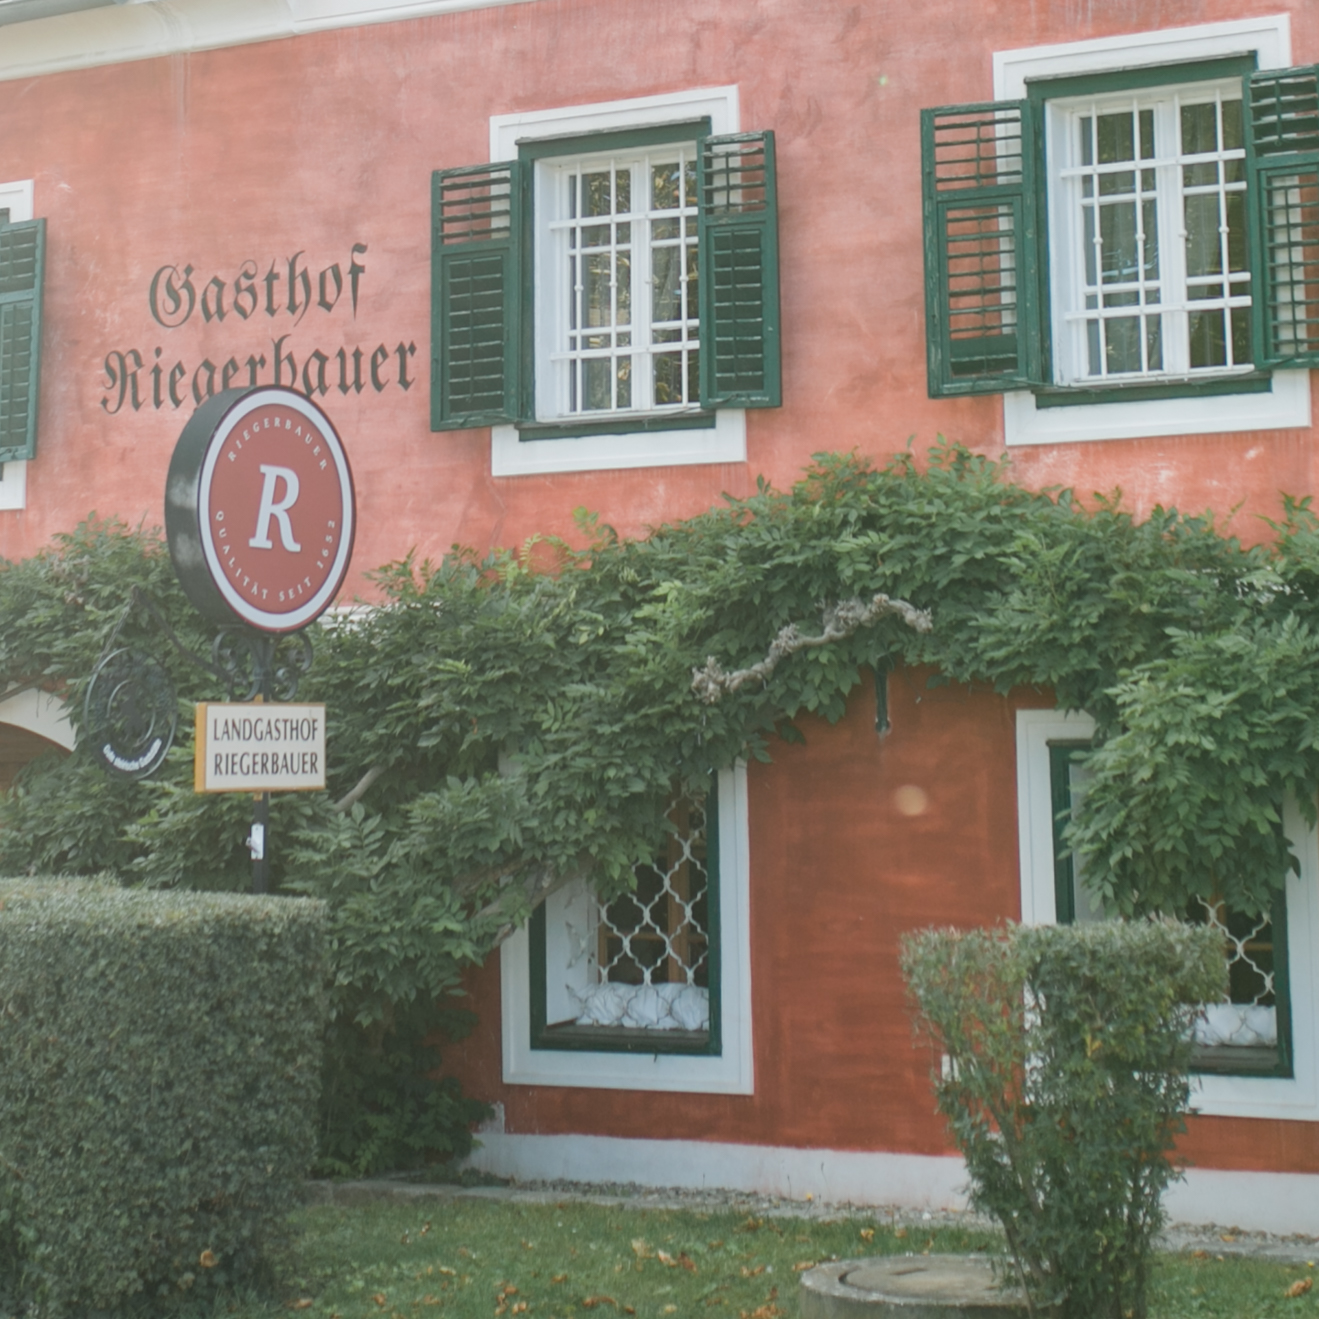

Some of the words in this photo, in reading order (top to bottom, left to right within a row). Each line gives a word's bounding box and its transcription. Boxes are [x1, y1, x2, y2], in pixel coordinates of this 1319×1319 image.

[149, 242, 368, 328] Gasthof
[227, 416, 328, 471] RIEGERBAUER
[248, 463, 302, 553] R
[215, 509, 269, 600] QUALITÄT
[279, 575, 312, 602] SEIT
[316, 519, 336, 570] 1652
[213, 717, 319, 742] LANDGASTHOF
[213, 751, 319, 776] RIEGERBAUER
